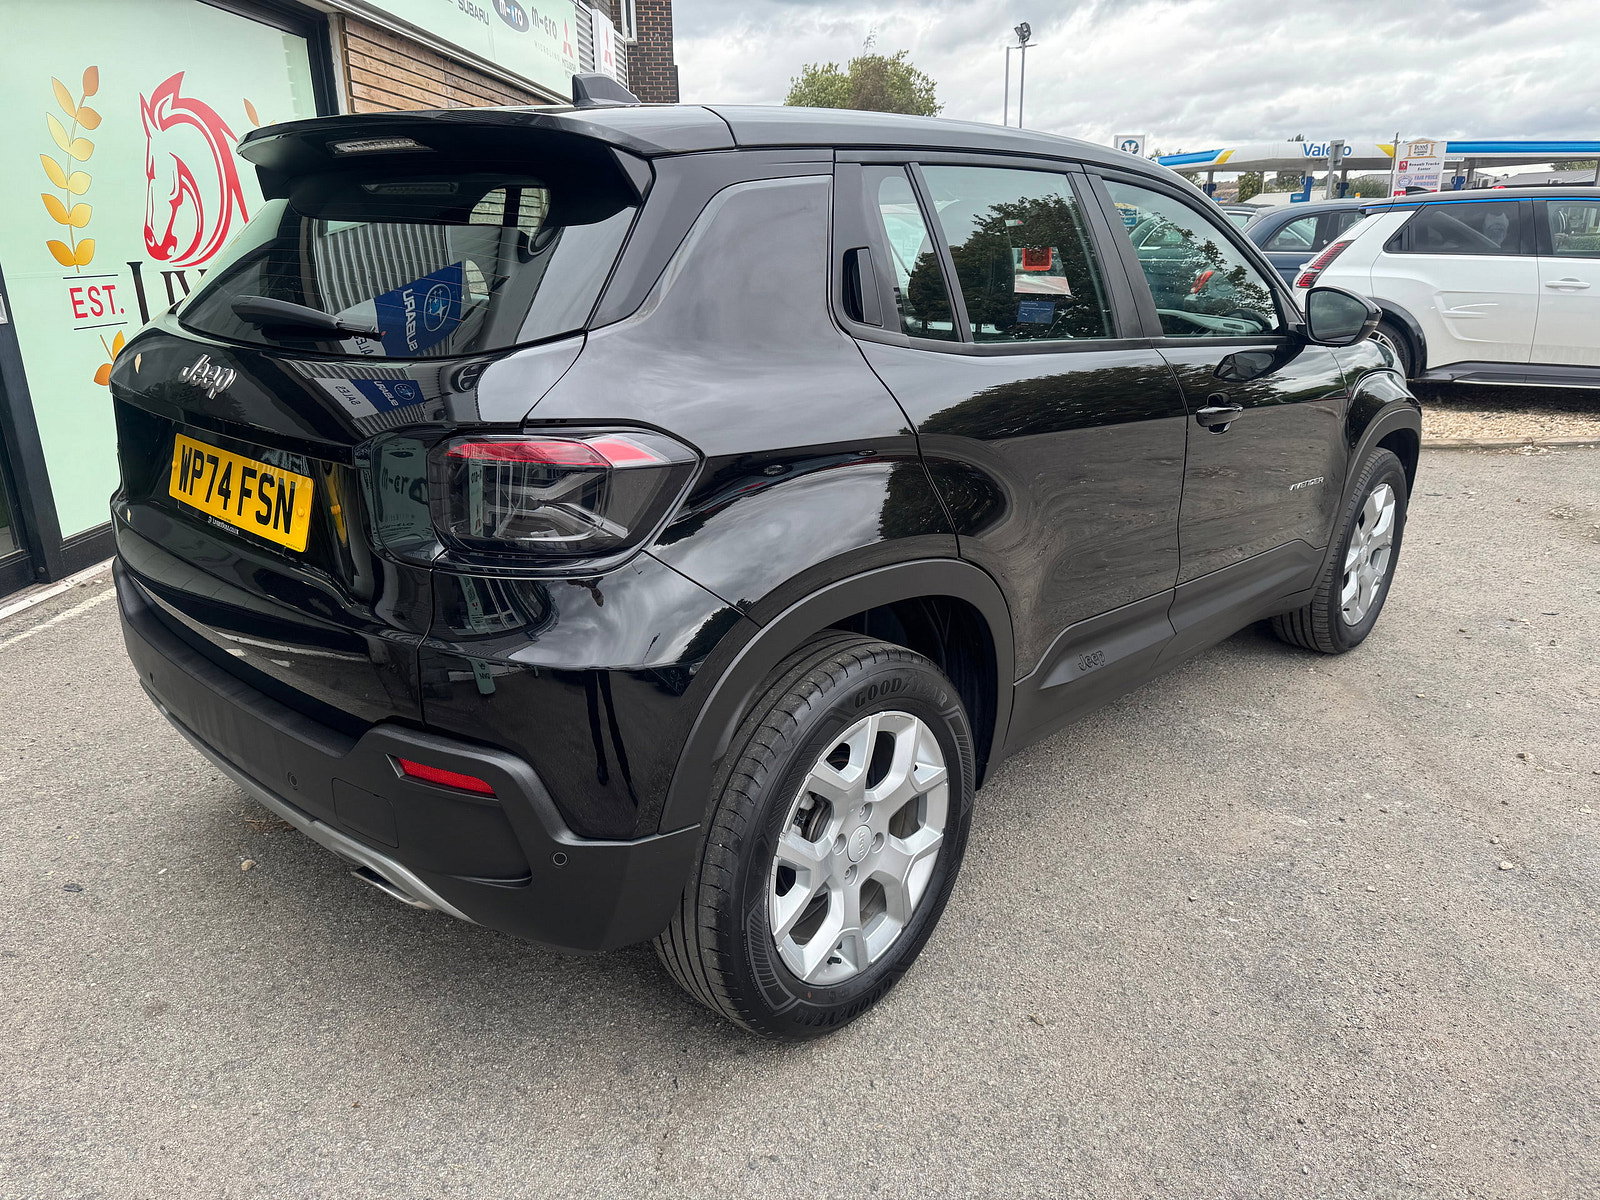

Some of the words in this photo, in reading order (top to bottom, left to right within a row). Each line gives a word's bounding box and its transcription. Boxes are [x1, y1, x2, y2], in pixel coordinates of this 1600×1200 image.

[458, 0, 490, 26] SUBARU
[1303, 143, 1352, 157] Valeo
[69, 285, 125, 319] EST.
[178, 353, 238, 400] Jeep
[178, 444, 233, 511] WP74
[237, 465, 297, 535] FSN
[1077, 650, 1106, 672] Jeep
